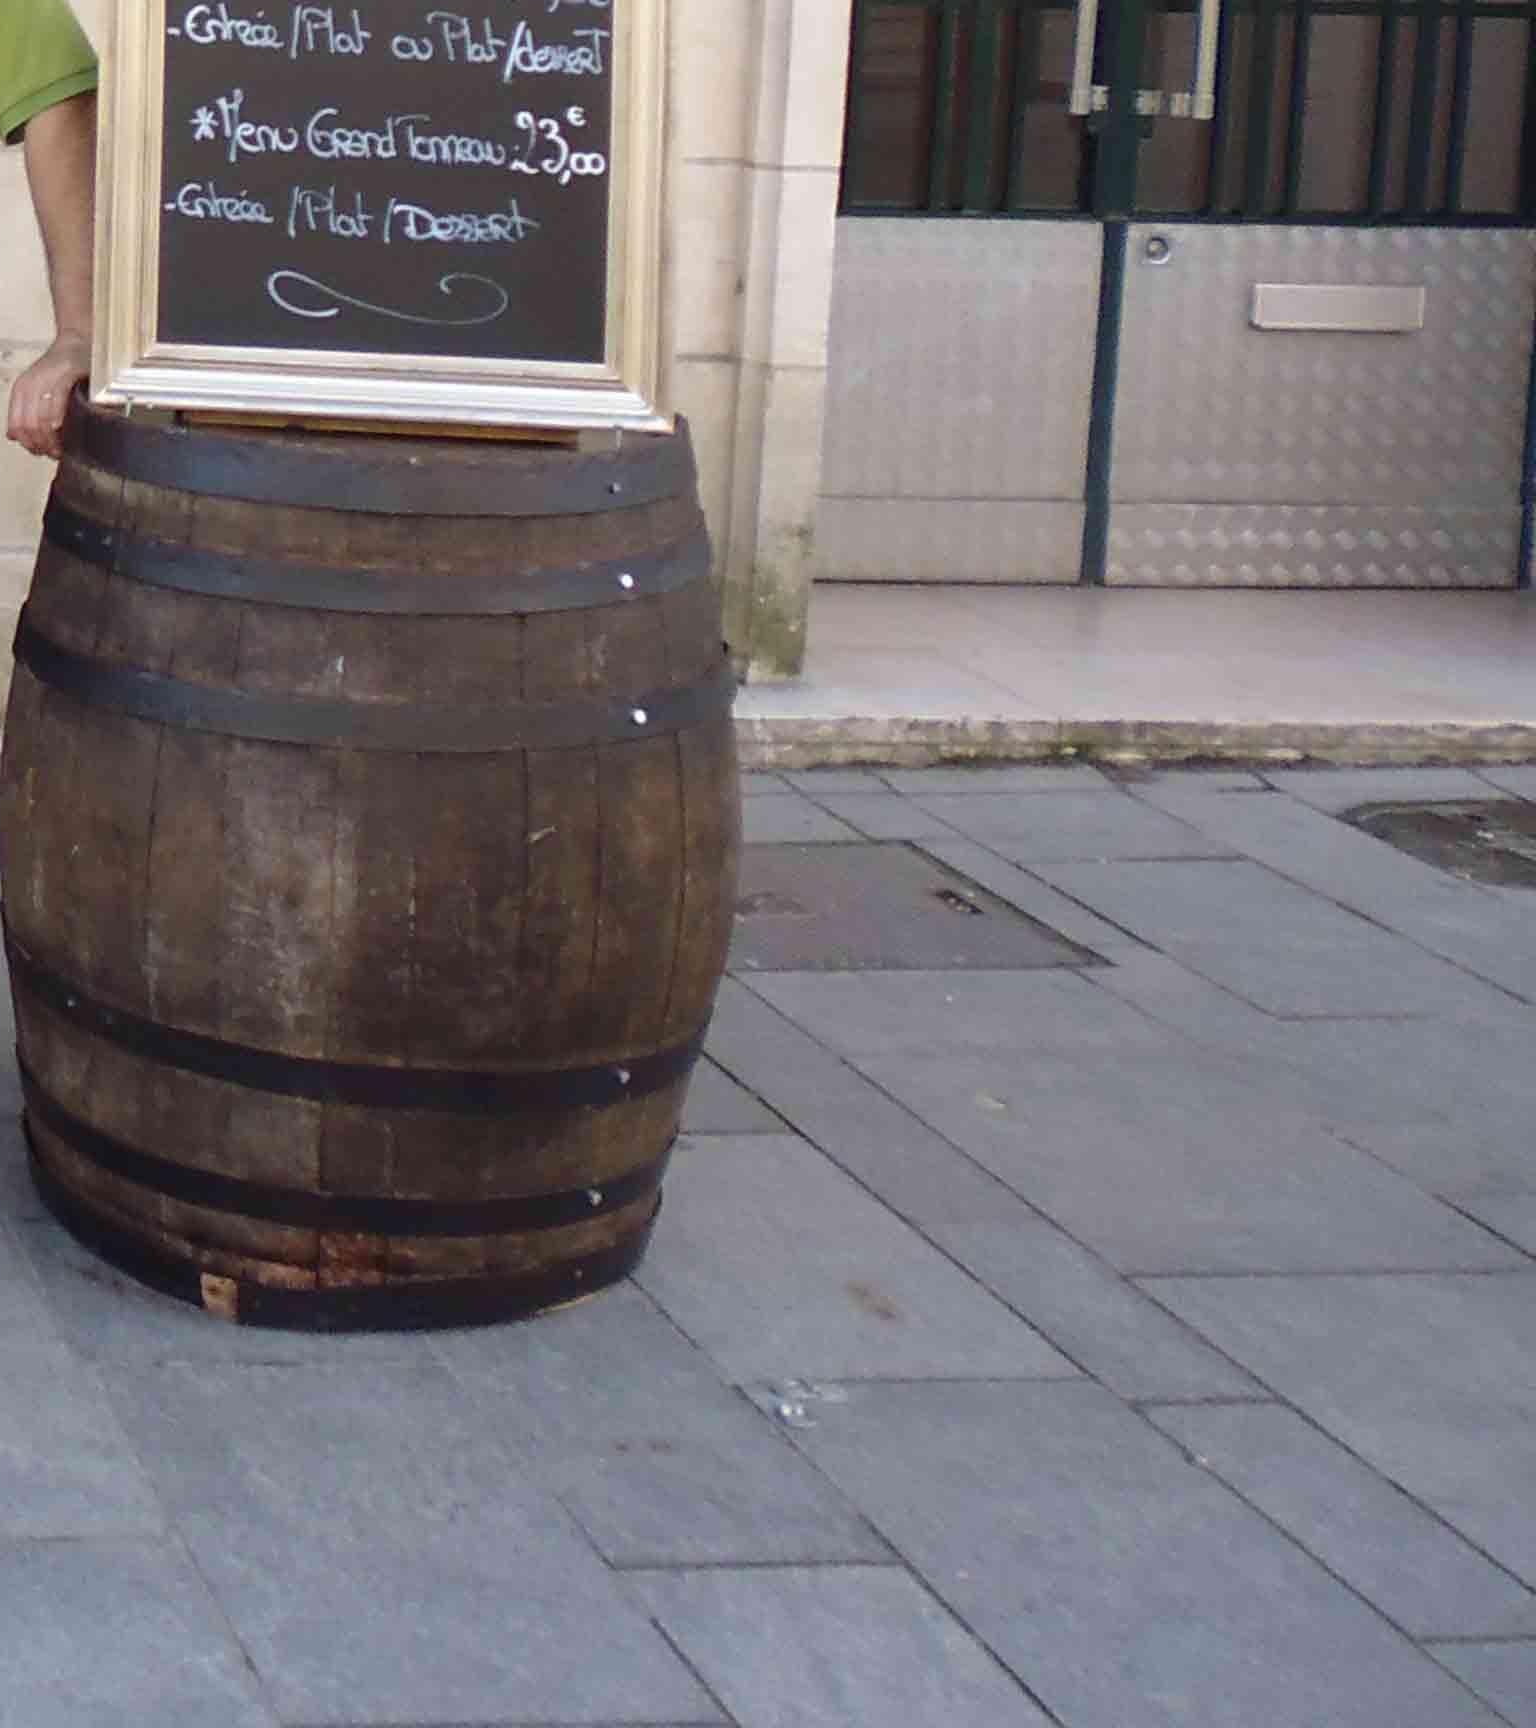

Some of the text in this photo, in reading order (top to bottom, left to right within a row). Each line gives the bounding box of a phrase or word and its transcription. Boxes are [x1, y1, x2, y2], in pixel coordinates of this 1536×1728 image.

[392, 34, 433, 61] ou
[215, 88, 299, 163] Menu
[306, 107, 397, 159] Grand
